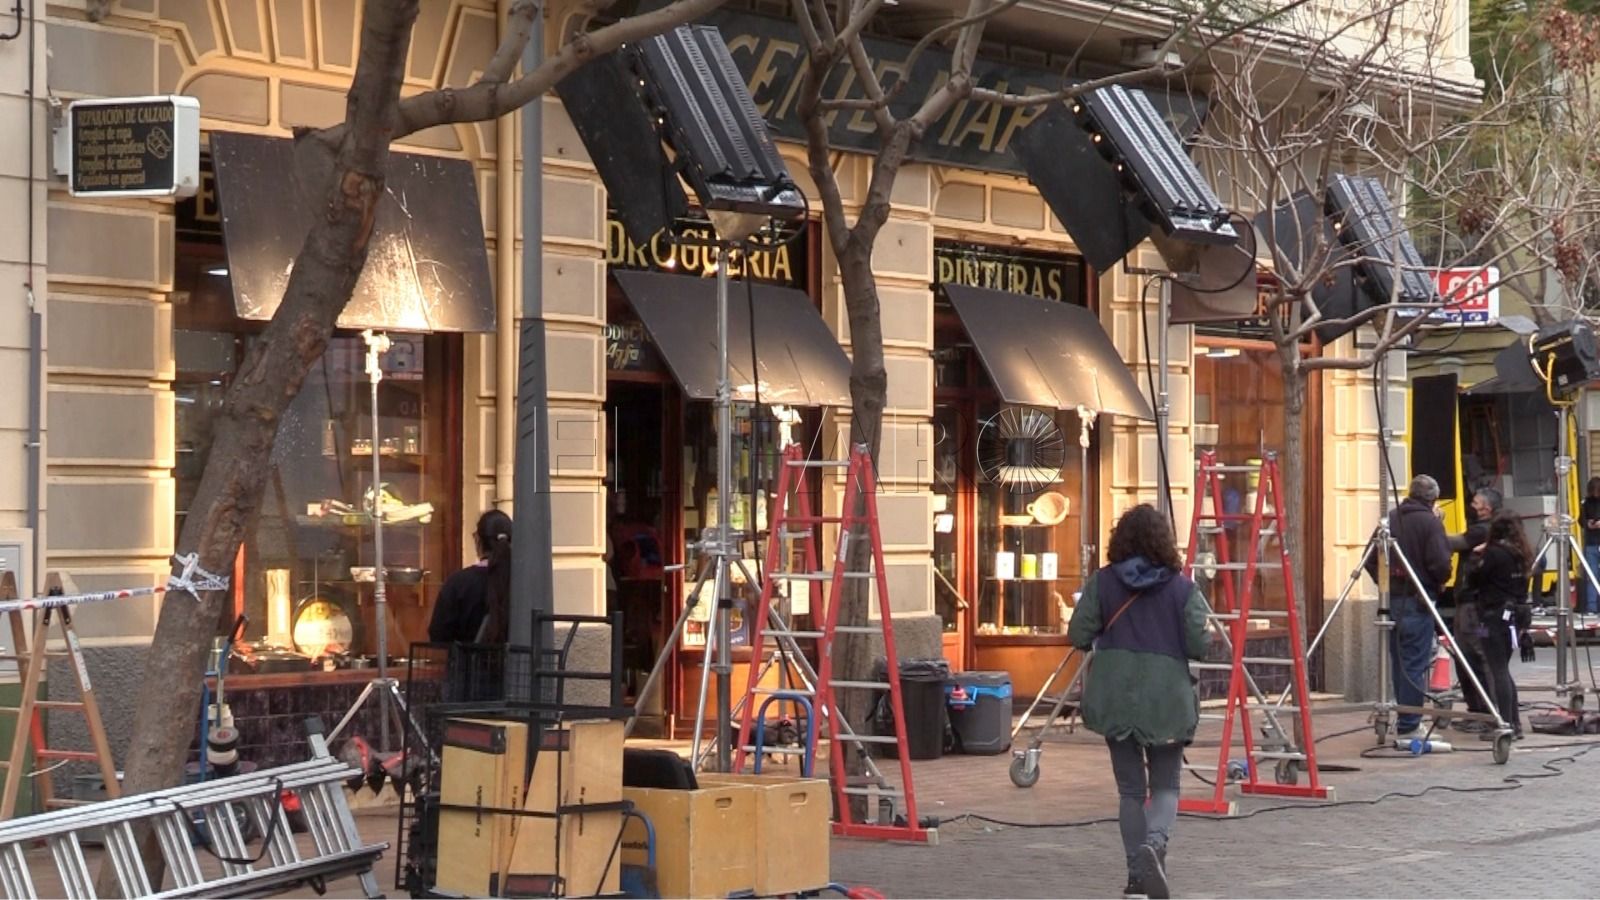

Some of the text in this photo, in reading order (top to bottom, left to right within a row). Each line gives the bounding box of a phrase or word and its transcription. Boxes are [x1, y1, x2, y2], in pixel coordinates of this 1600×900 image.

[125, 108, 137, 124] DE
[138, 106, 174, 123] CALZADO
[106, 126, 116, 140] de
[106, 157, 115, 170] de
